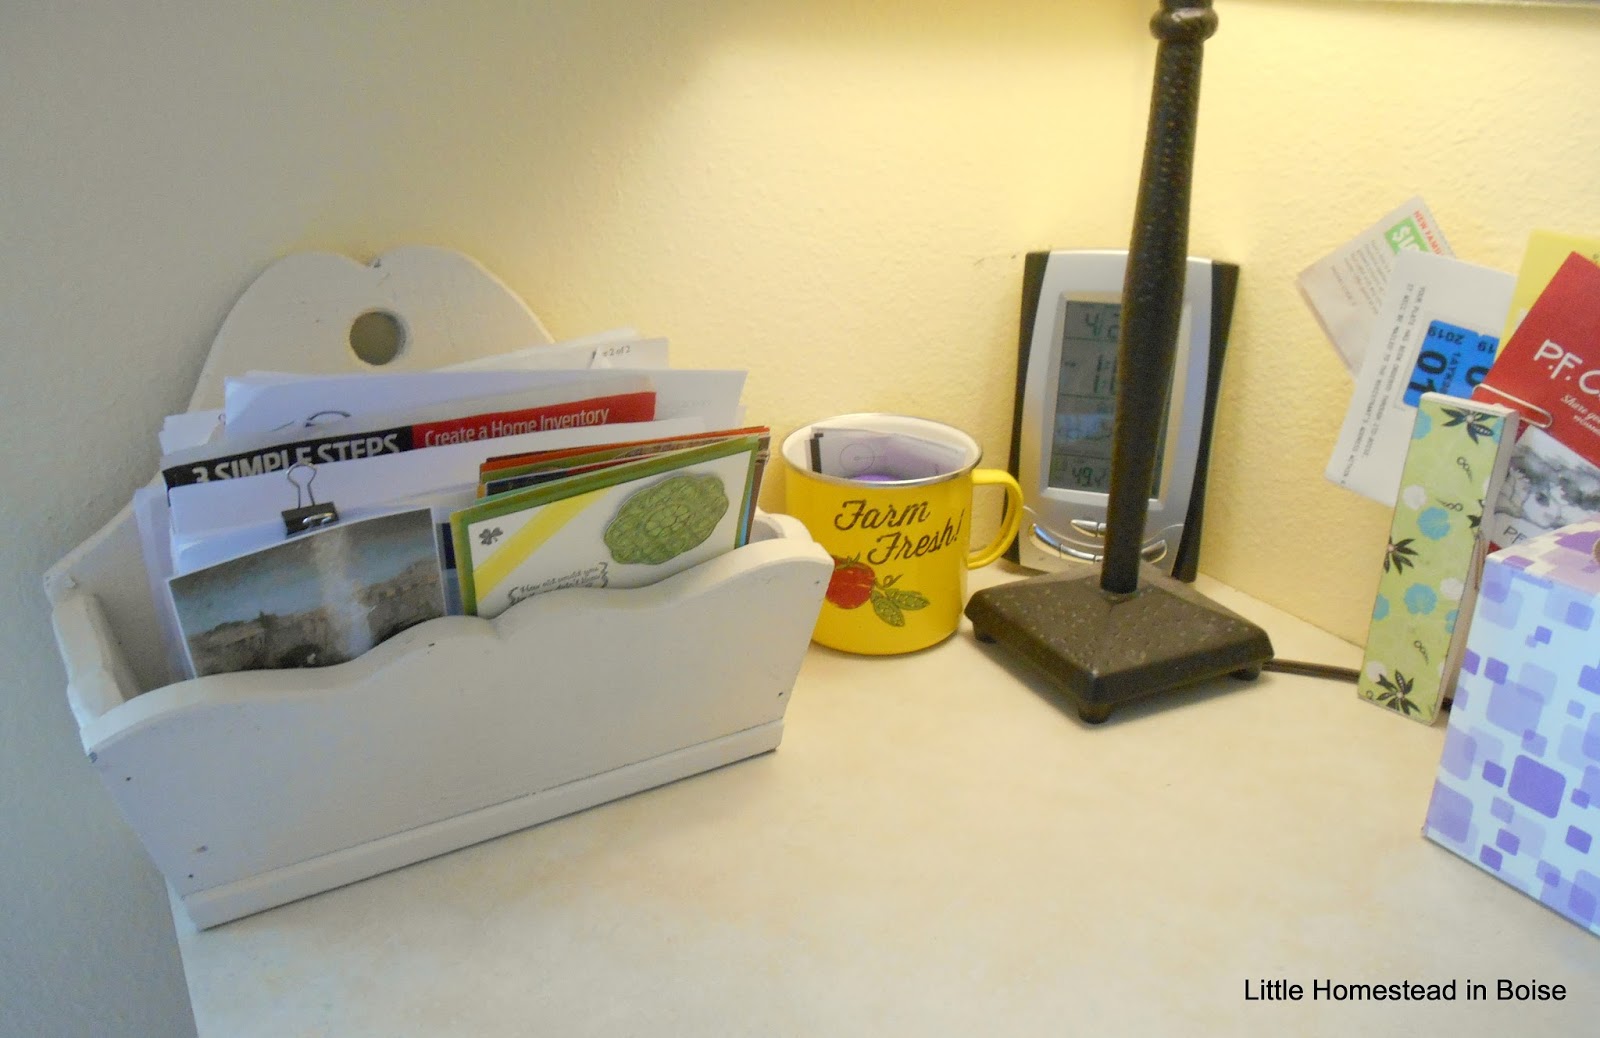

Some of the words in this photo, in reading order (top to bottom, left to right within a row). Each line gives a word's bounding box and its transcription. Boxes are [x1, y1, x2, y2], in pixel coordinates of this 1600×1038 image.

[1427, 325, 1465, 346] 2019
[1578, 369, 1600, 396] C
[317, 433, 400, 462] STEPS
[424, 427, 475, 448] Create
[479, 427, 489, 440] a
[491, 420, 537, 438] Home
[540, 408, 610, 430] Inventory
[834, 499, 931, 531] Farm
[867, 508, 965, 565] Fresh!
